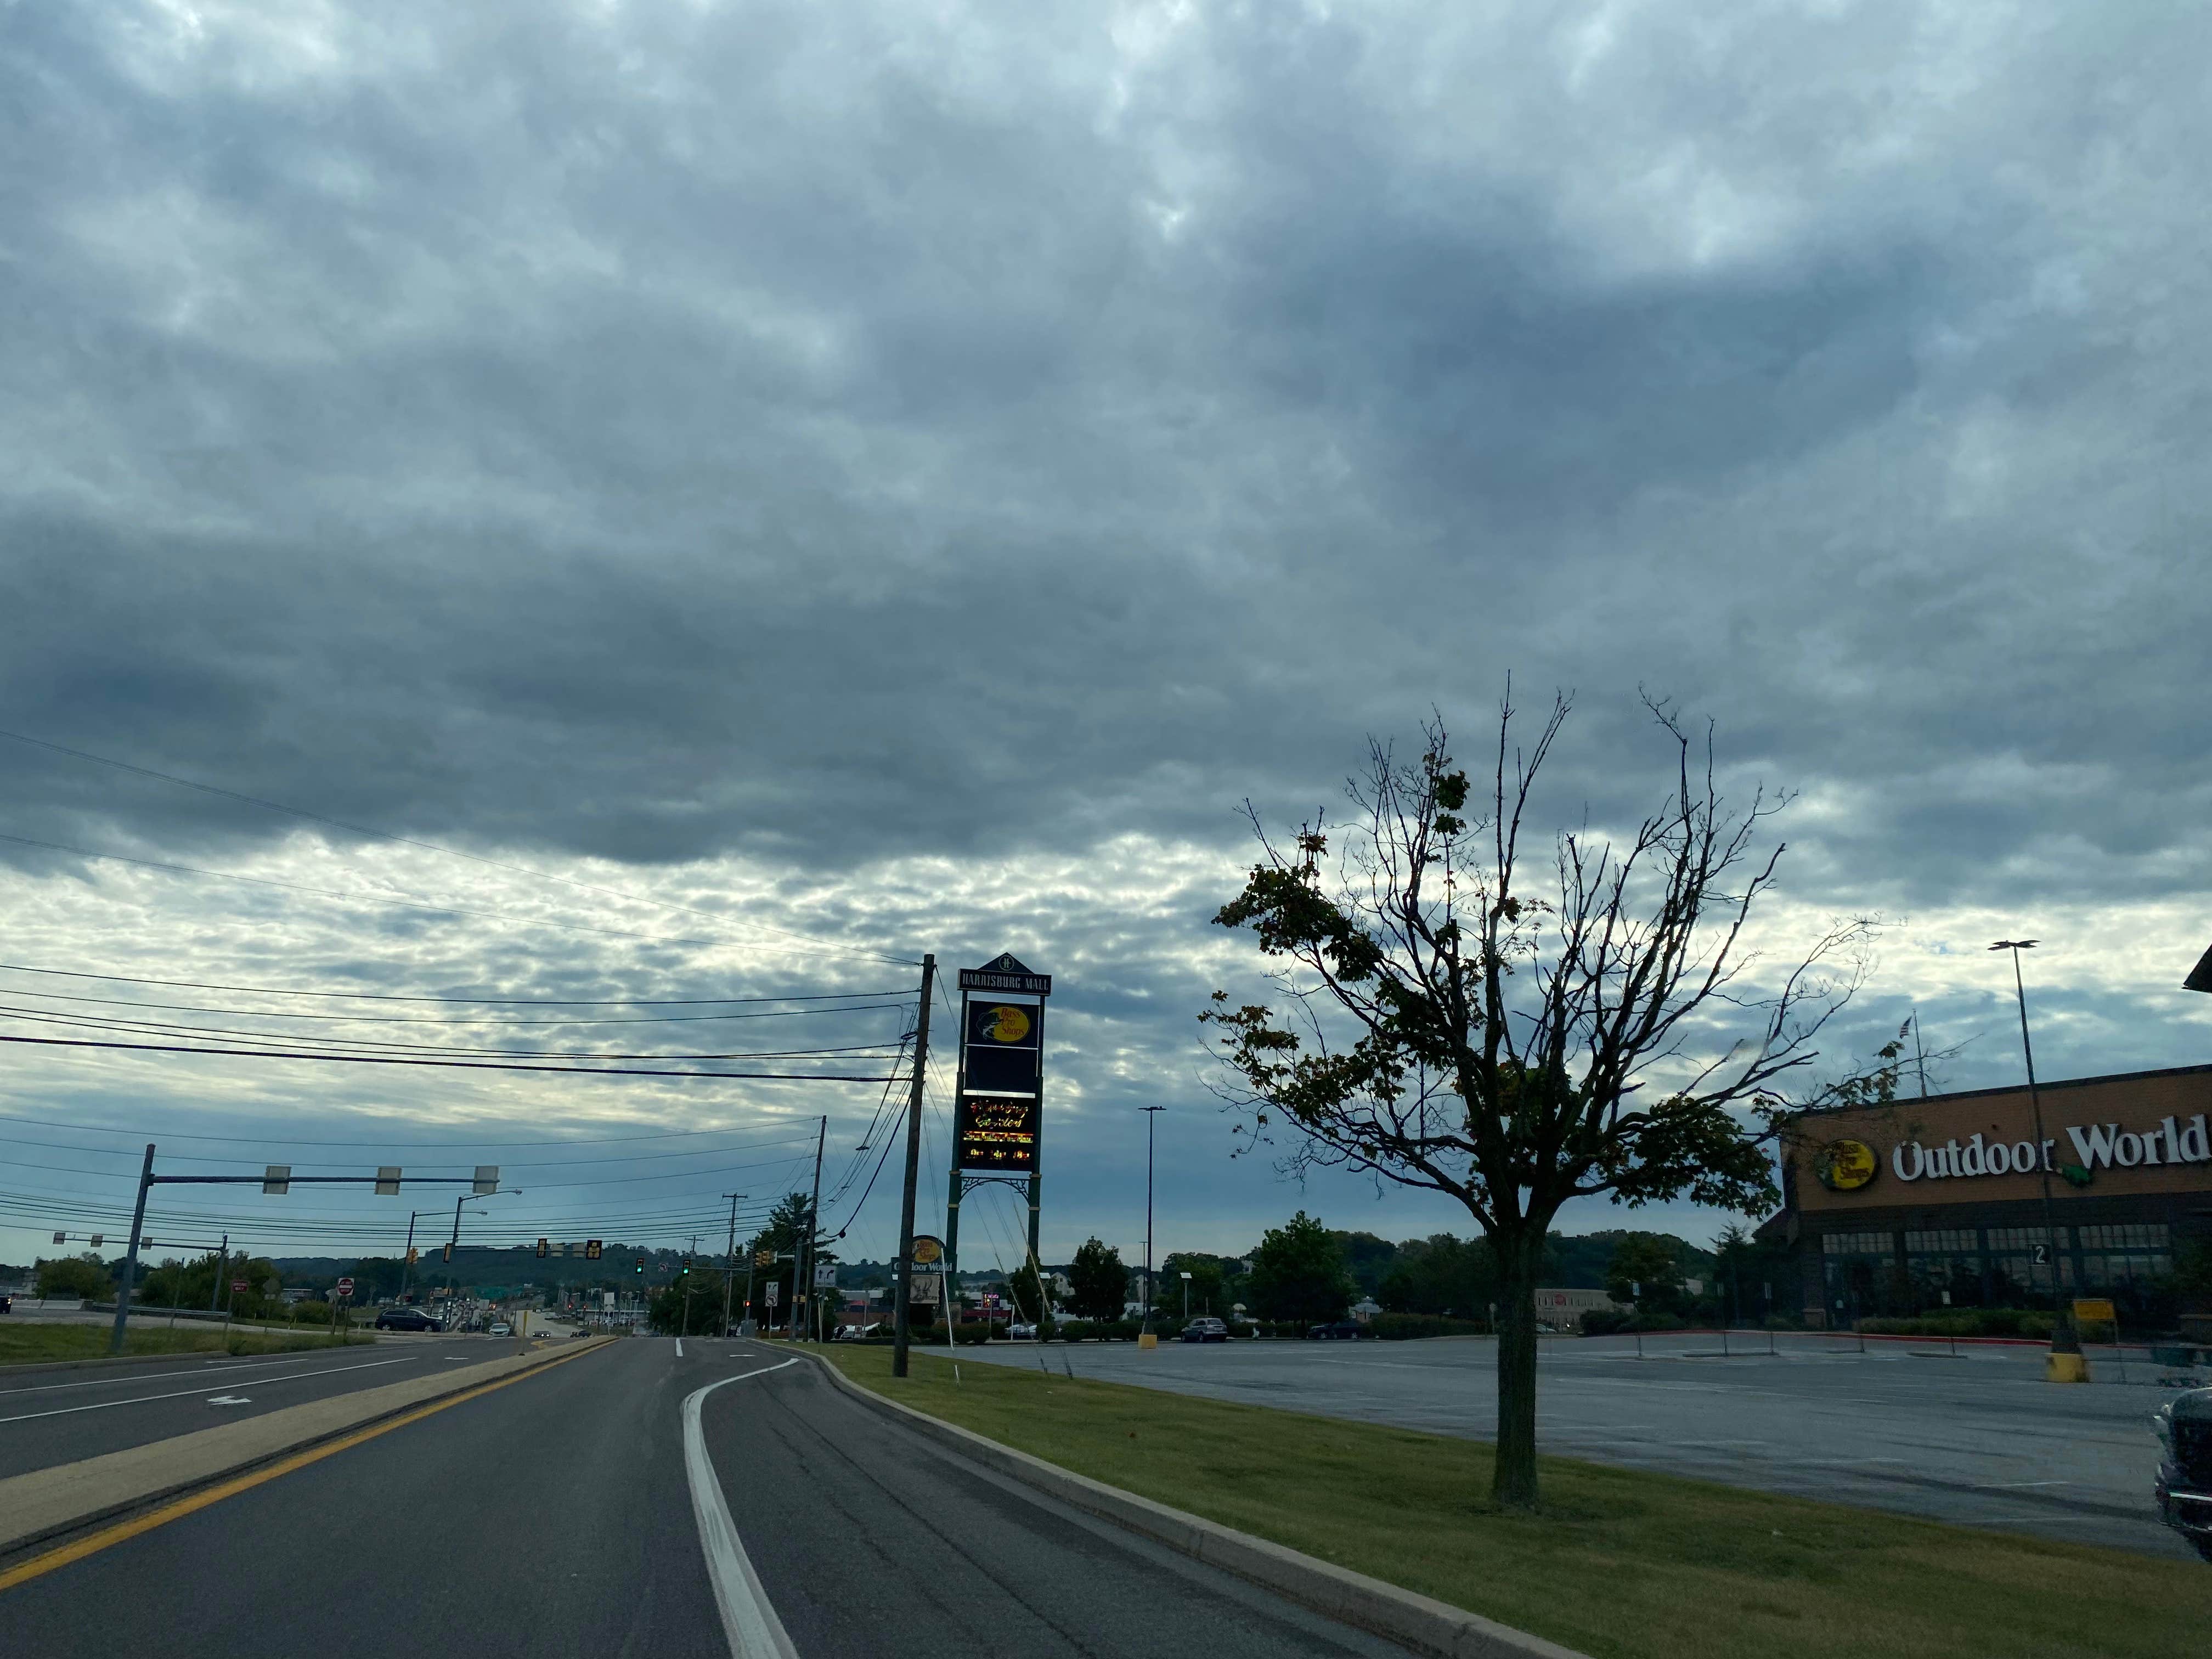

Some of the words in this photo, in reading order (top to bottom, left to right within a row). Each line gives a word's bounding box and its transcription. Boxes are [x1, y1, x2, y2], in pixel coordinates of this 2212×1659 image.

[963, 973, 1020, 989] HARRISBURG
[1026, 978, 1048, 990] MALL
[1001, 1008, 1021, 1018] Bass
[1000, 1018, 1015, 1026] Pro
[1001, 1026, 1024, 1037] Shops
[1893, 1133, 2055, 1181] Outdoor
[2066, 1114, 2212, 1169] World
[2036, 1245, 2045, 1263] 2
[894, 1262, 927, 1271] Ooor
[928, 1262, 952, 1272] World
